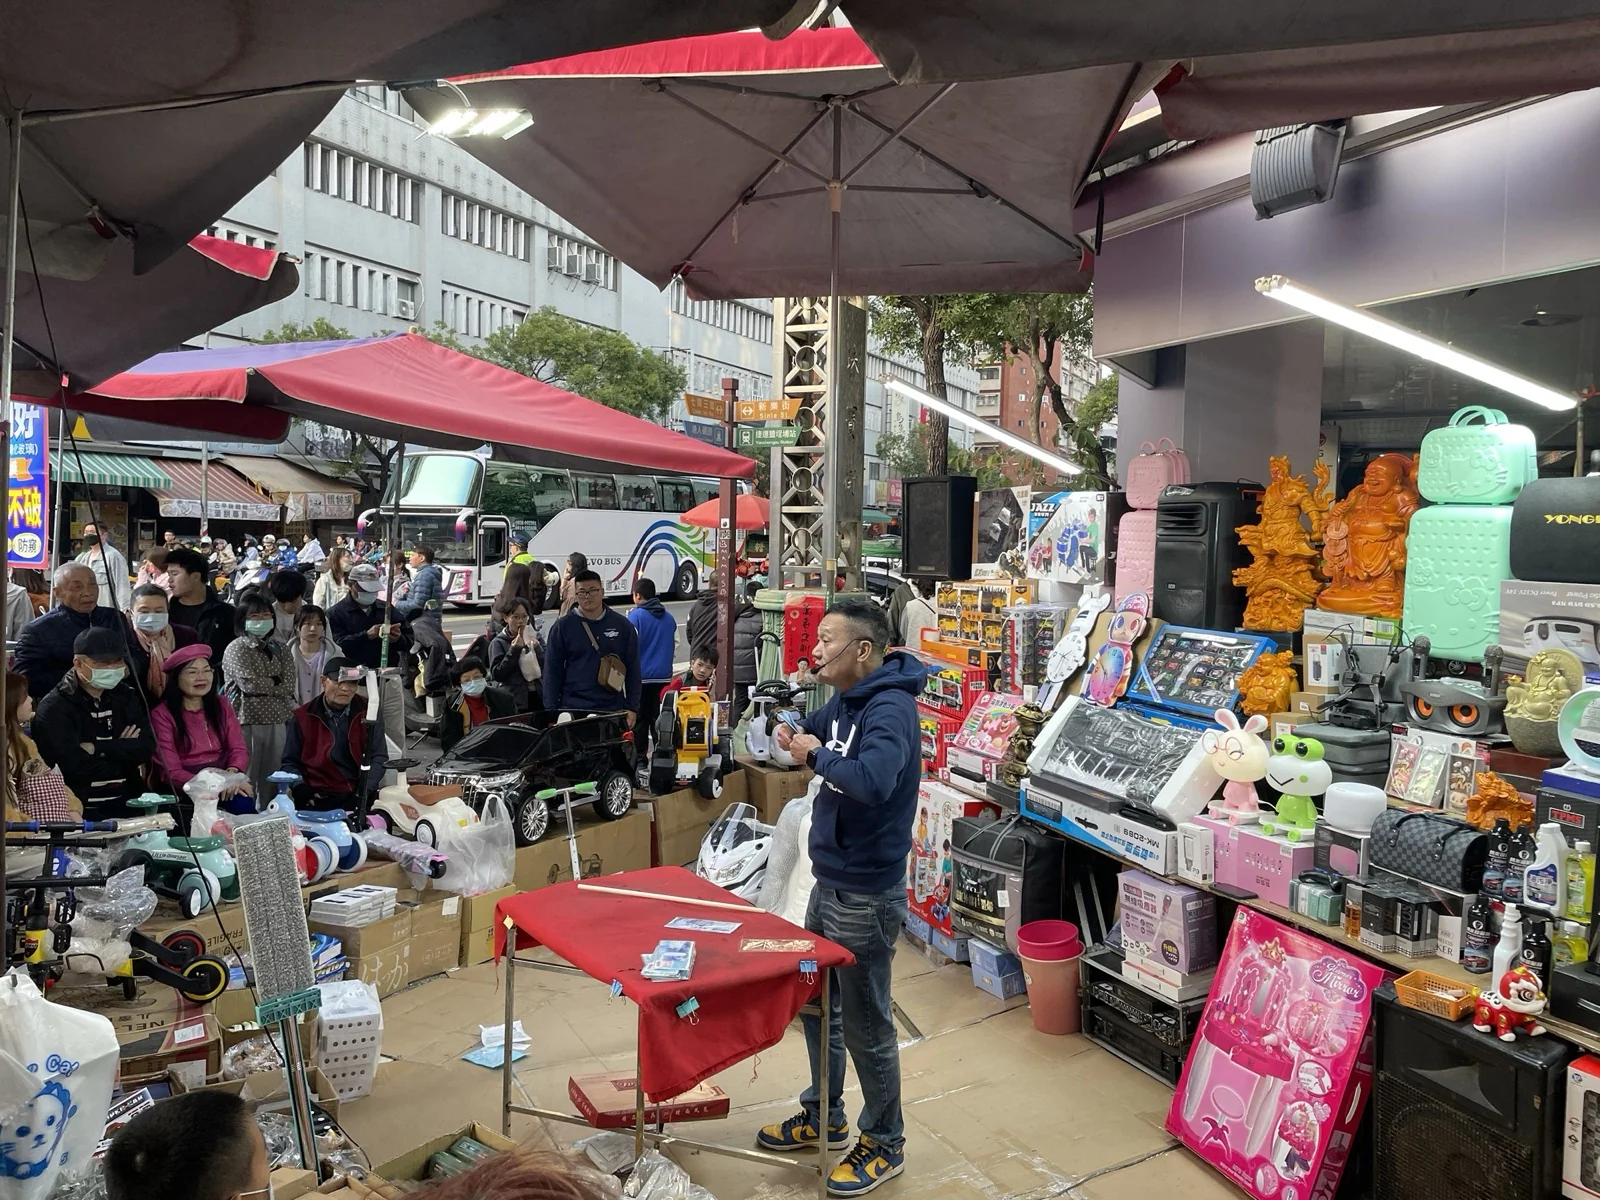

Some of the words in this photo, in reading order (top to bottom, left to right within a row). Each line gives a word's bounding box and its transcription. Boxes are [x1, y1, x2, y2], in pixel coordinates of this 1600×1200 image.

[758, 401, 790, 410] 新樂街
[1030, 502, 1056, 512] JAZZ
[1551, 809, 1582, 825] TPMS
[362, 954, 409, 992] はっか
[1313, 970, 1359, 998] Mirror
